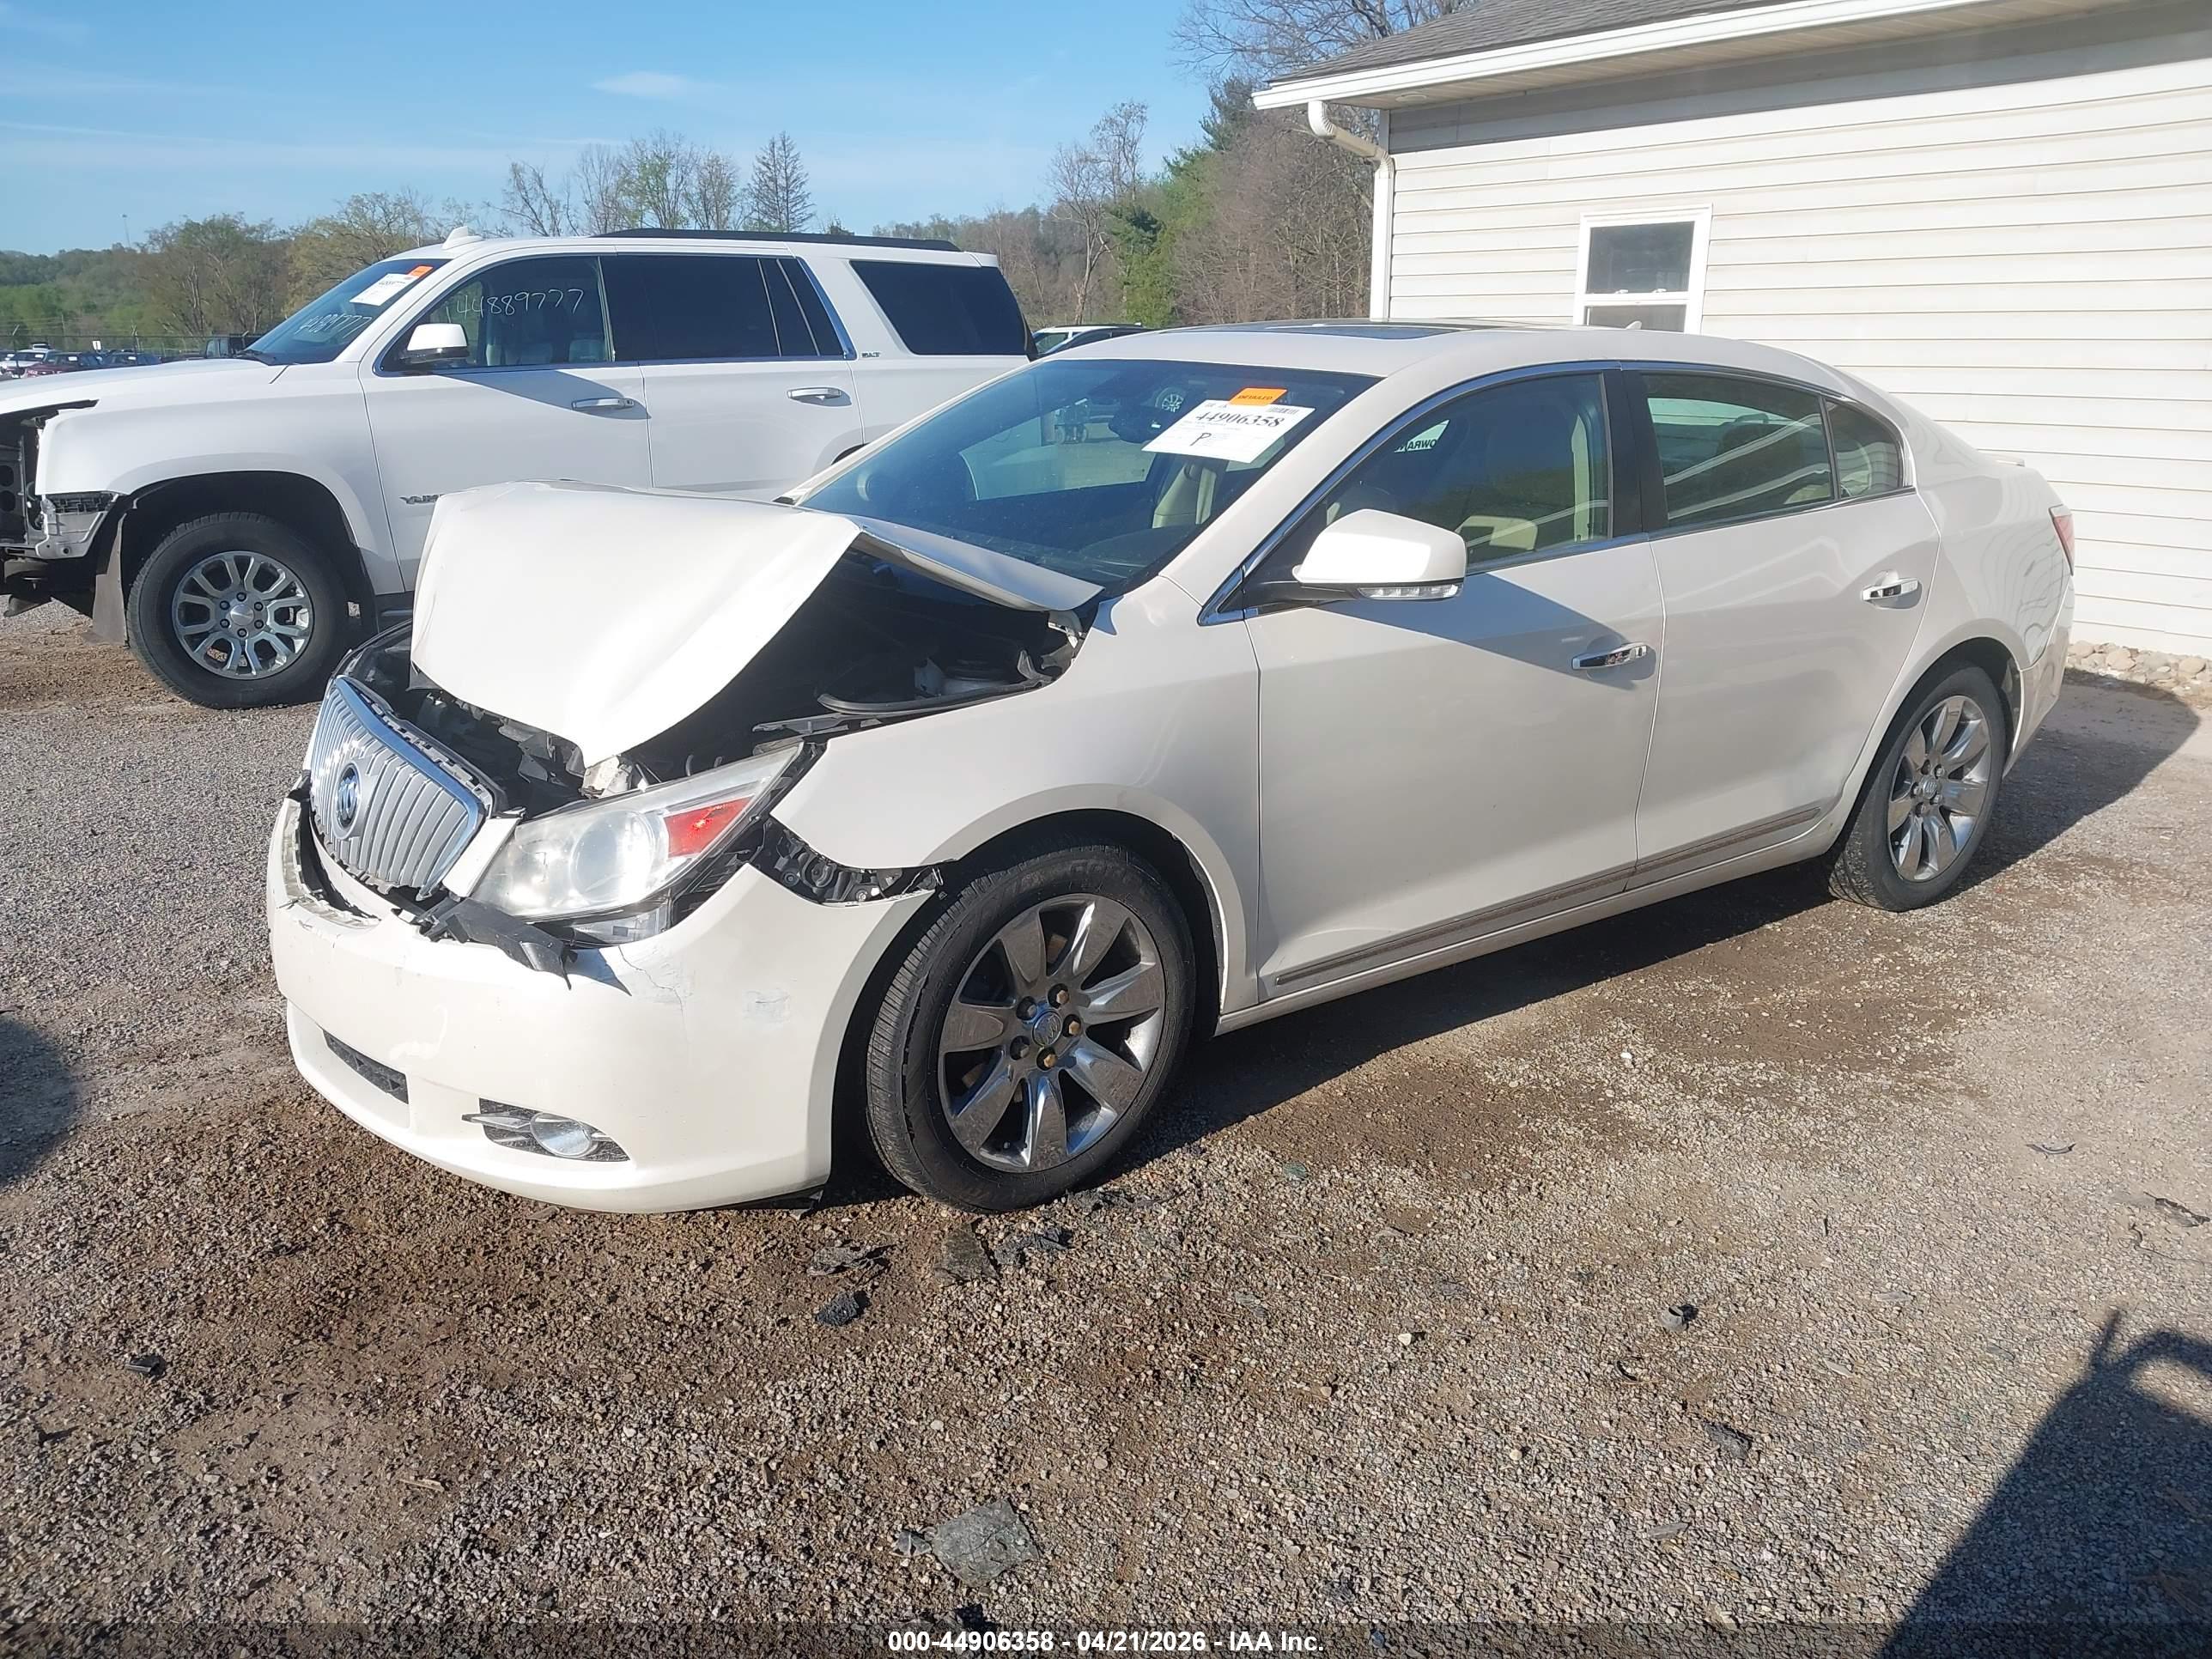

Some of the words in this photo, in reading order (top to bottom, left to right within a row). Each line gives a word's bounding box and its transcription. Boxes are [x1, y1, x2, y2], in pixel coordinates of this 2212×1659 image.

[456, 288, 584, 319] 44889777
[1195, 411, 1285, 428] 44906358
[1189, 431, 1212, 447] P
